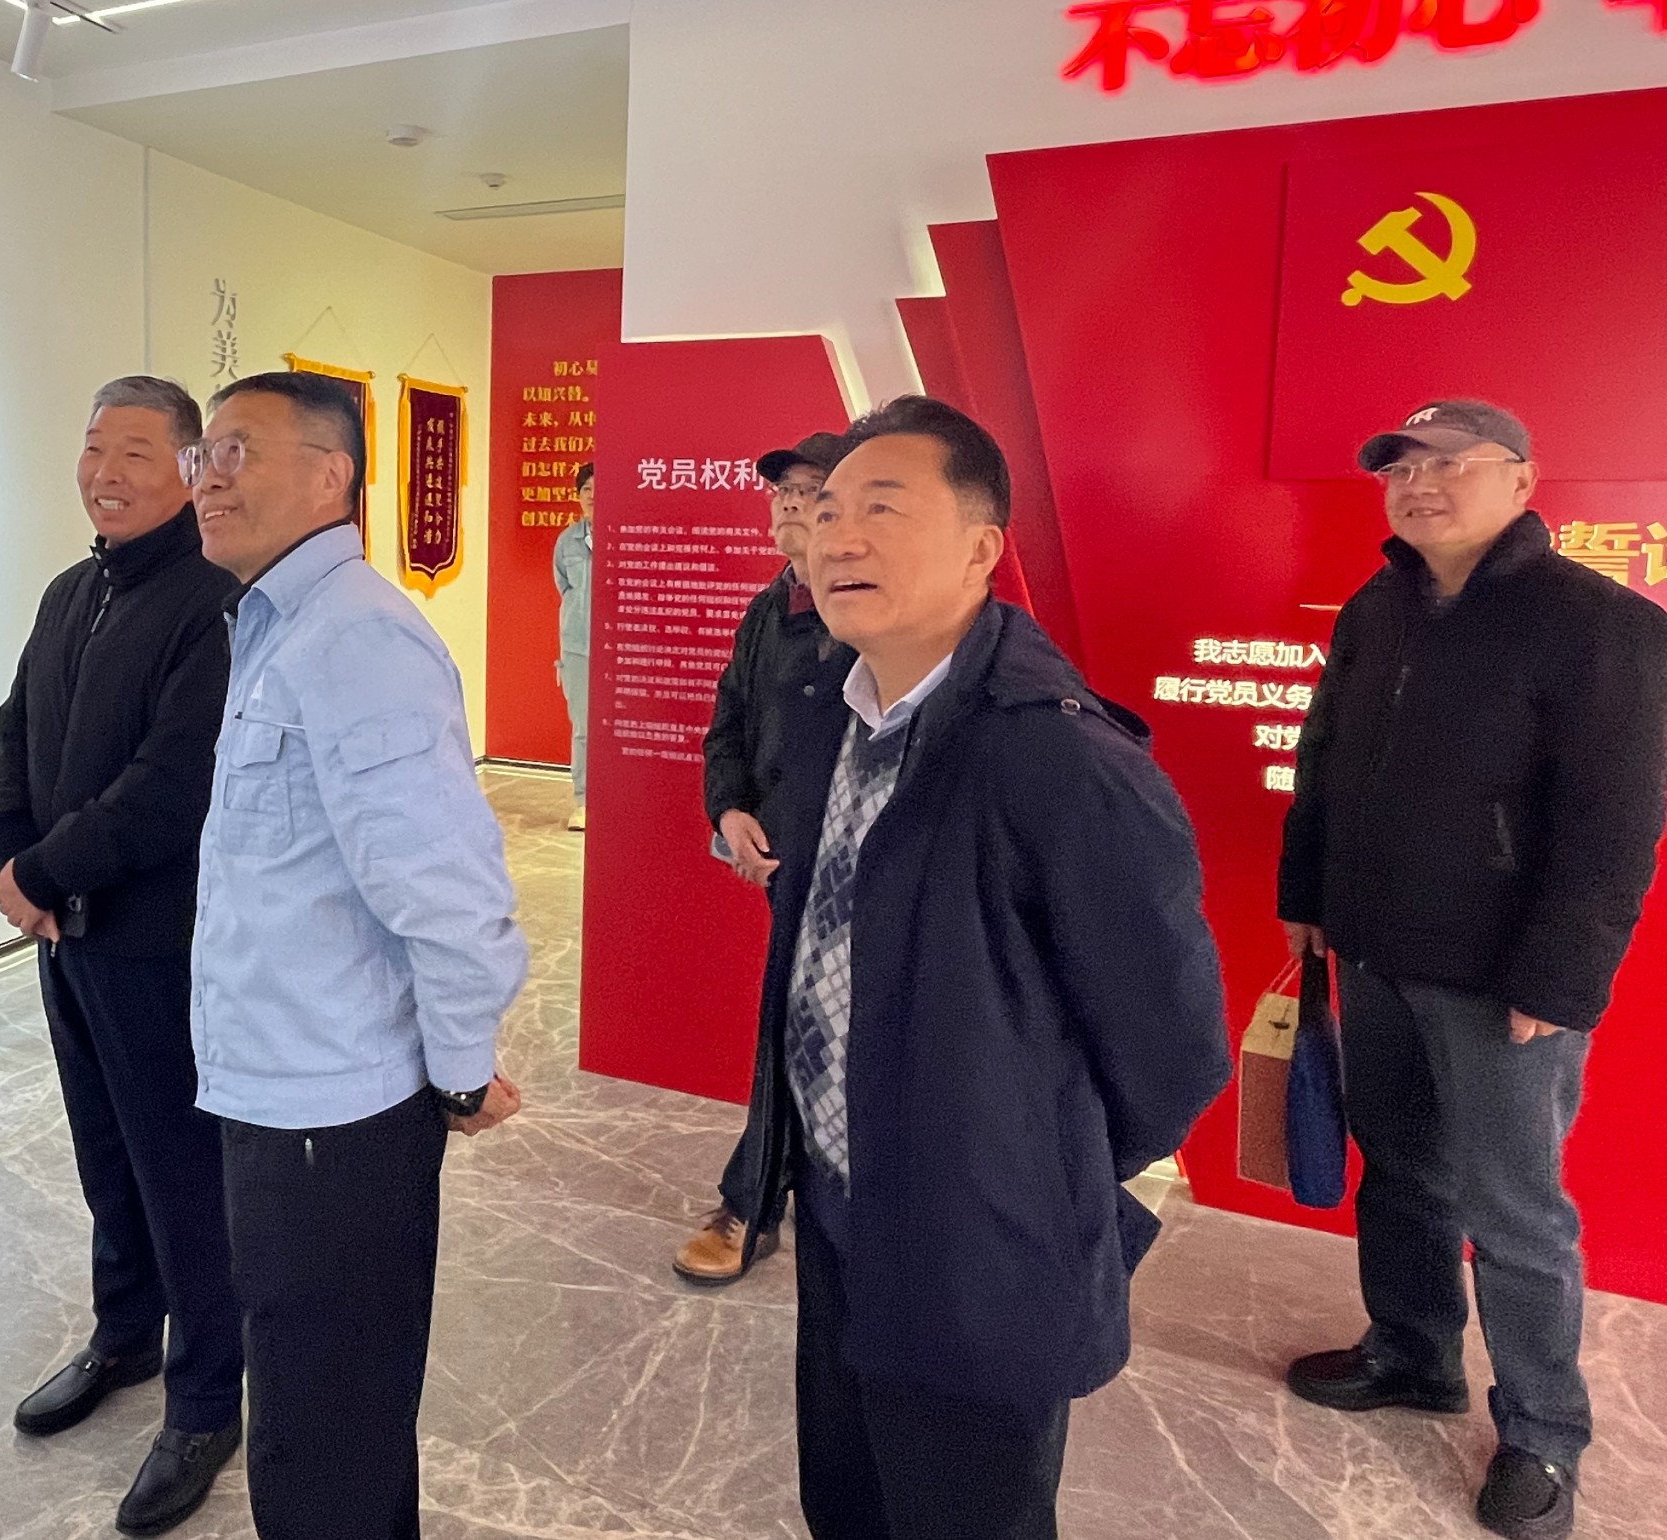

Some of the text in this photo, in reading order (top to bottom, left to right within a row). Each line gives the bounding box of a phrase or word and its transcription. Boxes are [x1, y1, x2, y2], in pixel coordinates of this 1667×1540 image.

[210, 277, 242, 396] 为美
[522, 461, 588, 478] 们怎样才
[636, 457, 765, 491] 党员权利
[1193, 638, 1327, 668] 我志愿加入
[1153, 676, 1313, 711] 履行党员义务
[1265, 766, 1296, 791] 随
